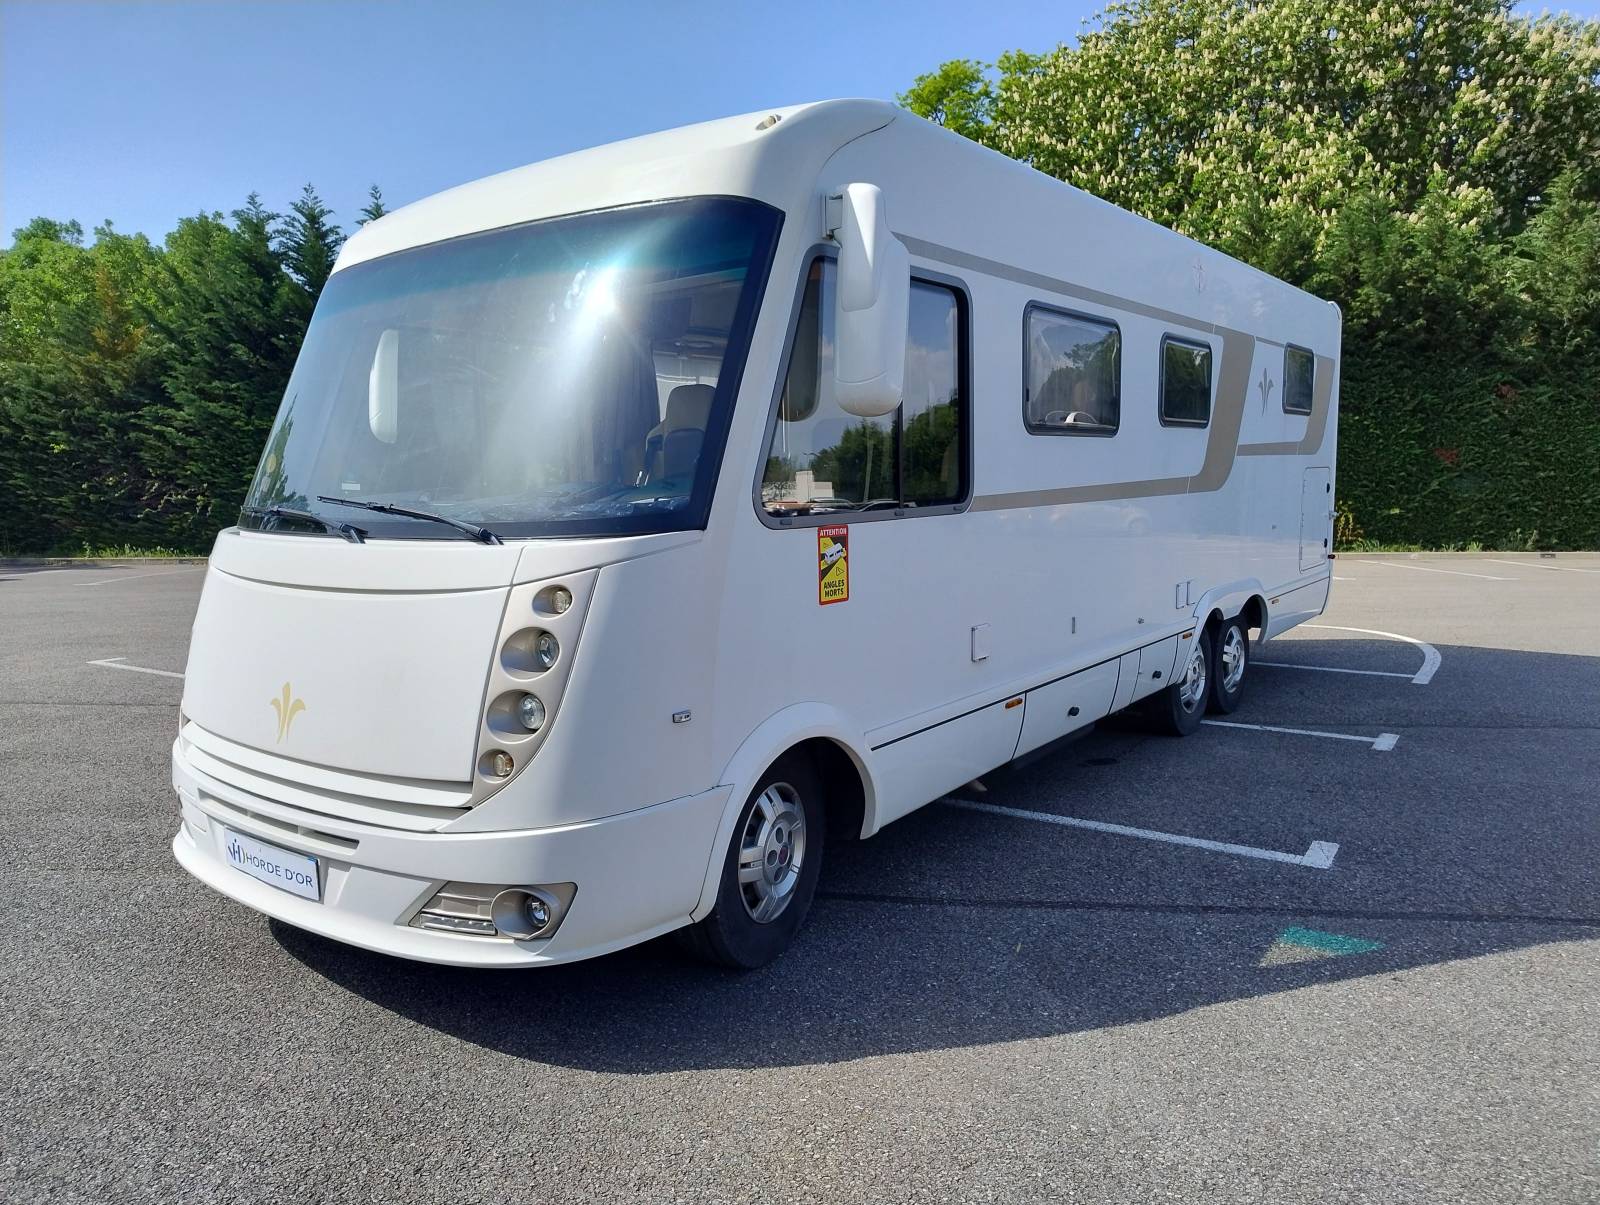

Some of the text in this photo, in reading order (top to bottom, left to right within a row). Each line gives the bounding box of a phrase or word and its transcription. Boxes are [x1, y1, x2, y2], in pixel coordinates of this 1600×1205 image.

[819, 527, 847, 537] ATTENTION
[823, 579, 845, 590] ANGLES
[824, 588, 844, 598] MORTS
[245, 852, 314, 888] HORDE D'OR
